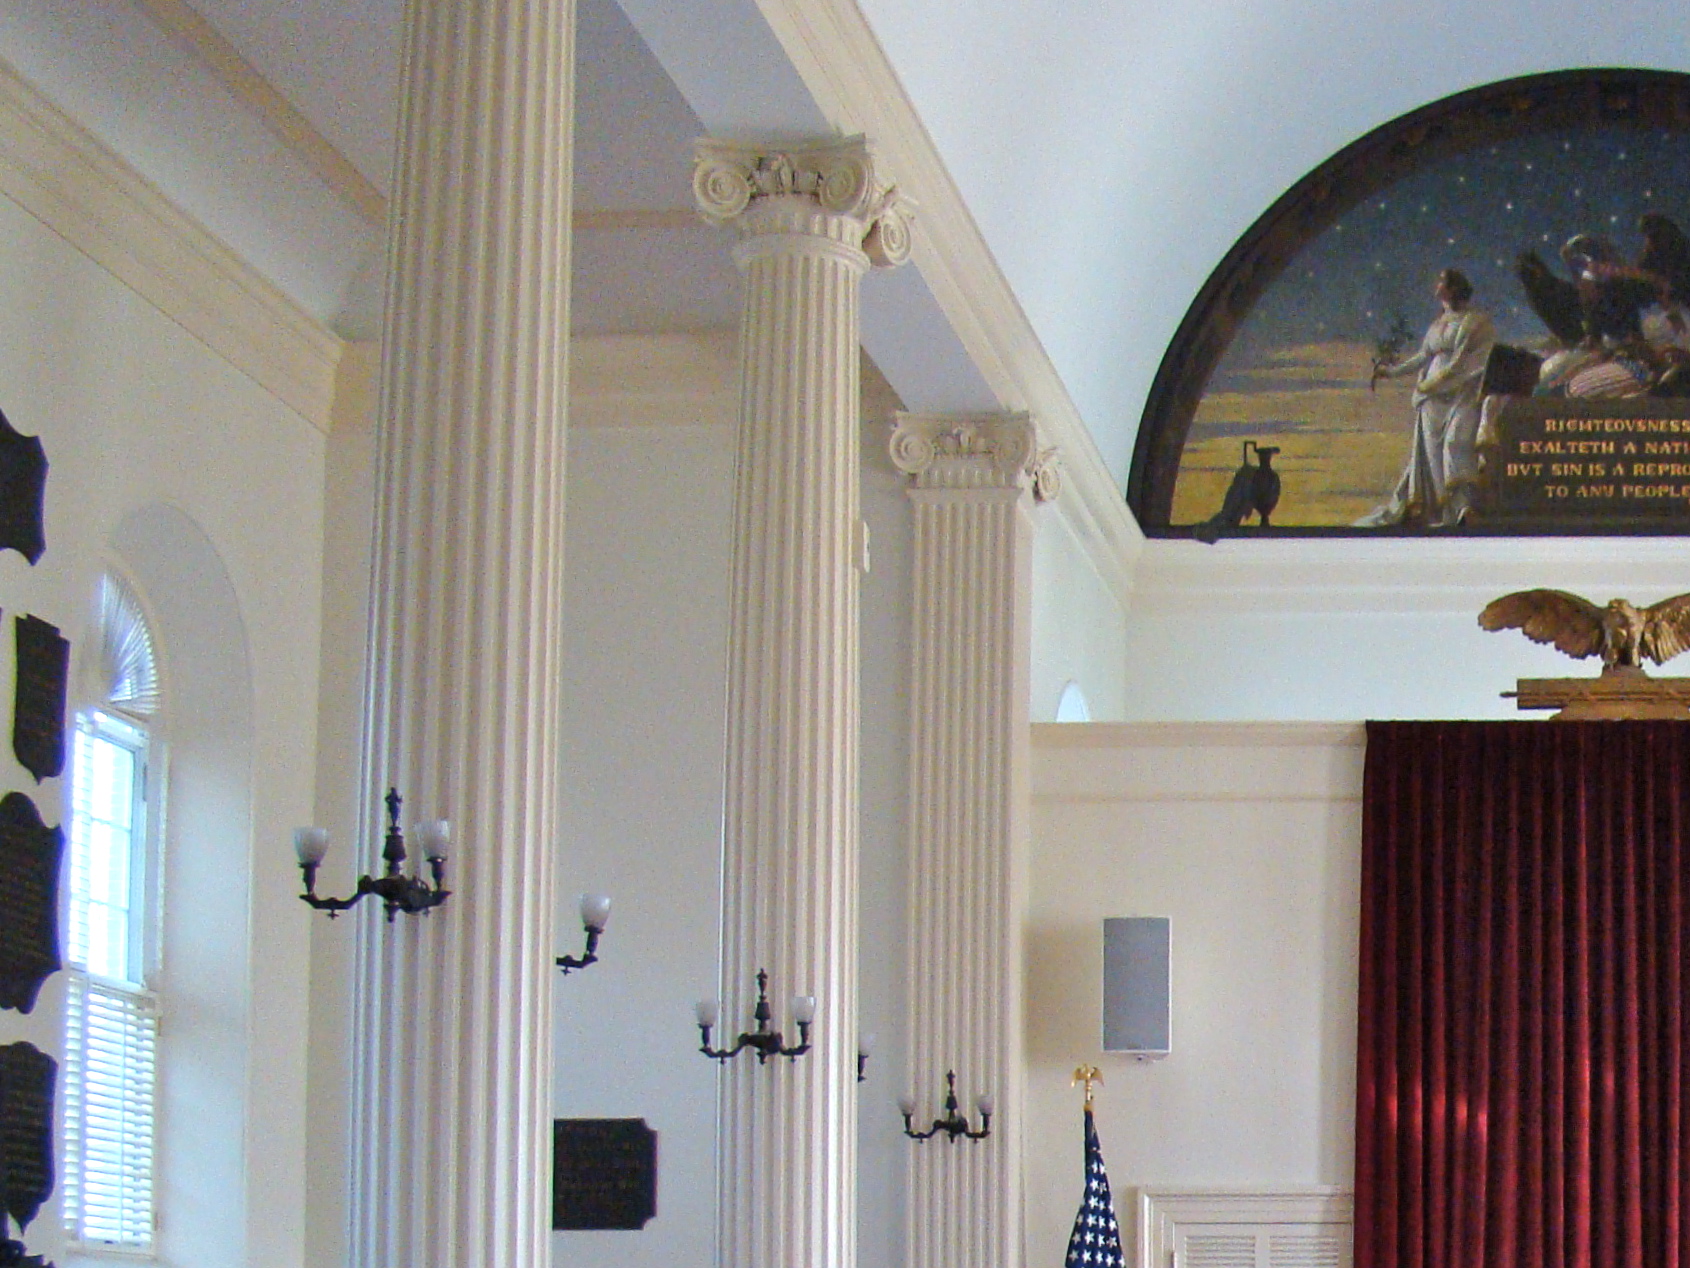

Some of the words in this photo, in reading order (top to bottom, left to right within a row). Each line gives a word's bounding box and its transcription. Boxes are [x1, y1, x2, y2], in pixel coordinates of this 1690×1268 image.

[1519, 441, 1615, 454] EXALTETH
[1623, 441, 1637, 454] A
[1551, 463, 1583, 476] SIN
[1589, 463, 1606, 476] IS
[1613, 463, 1625, 476] A
[1544, 485, 1569, 498] TO
